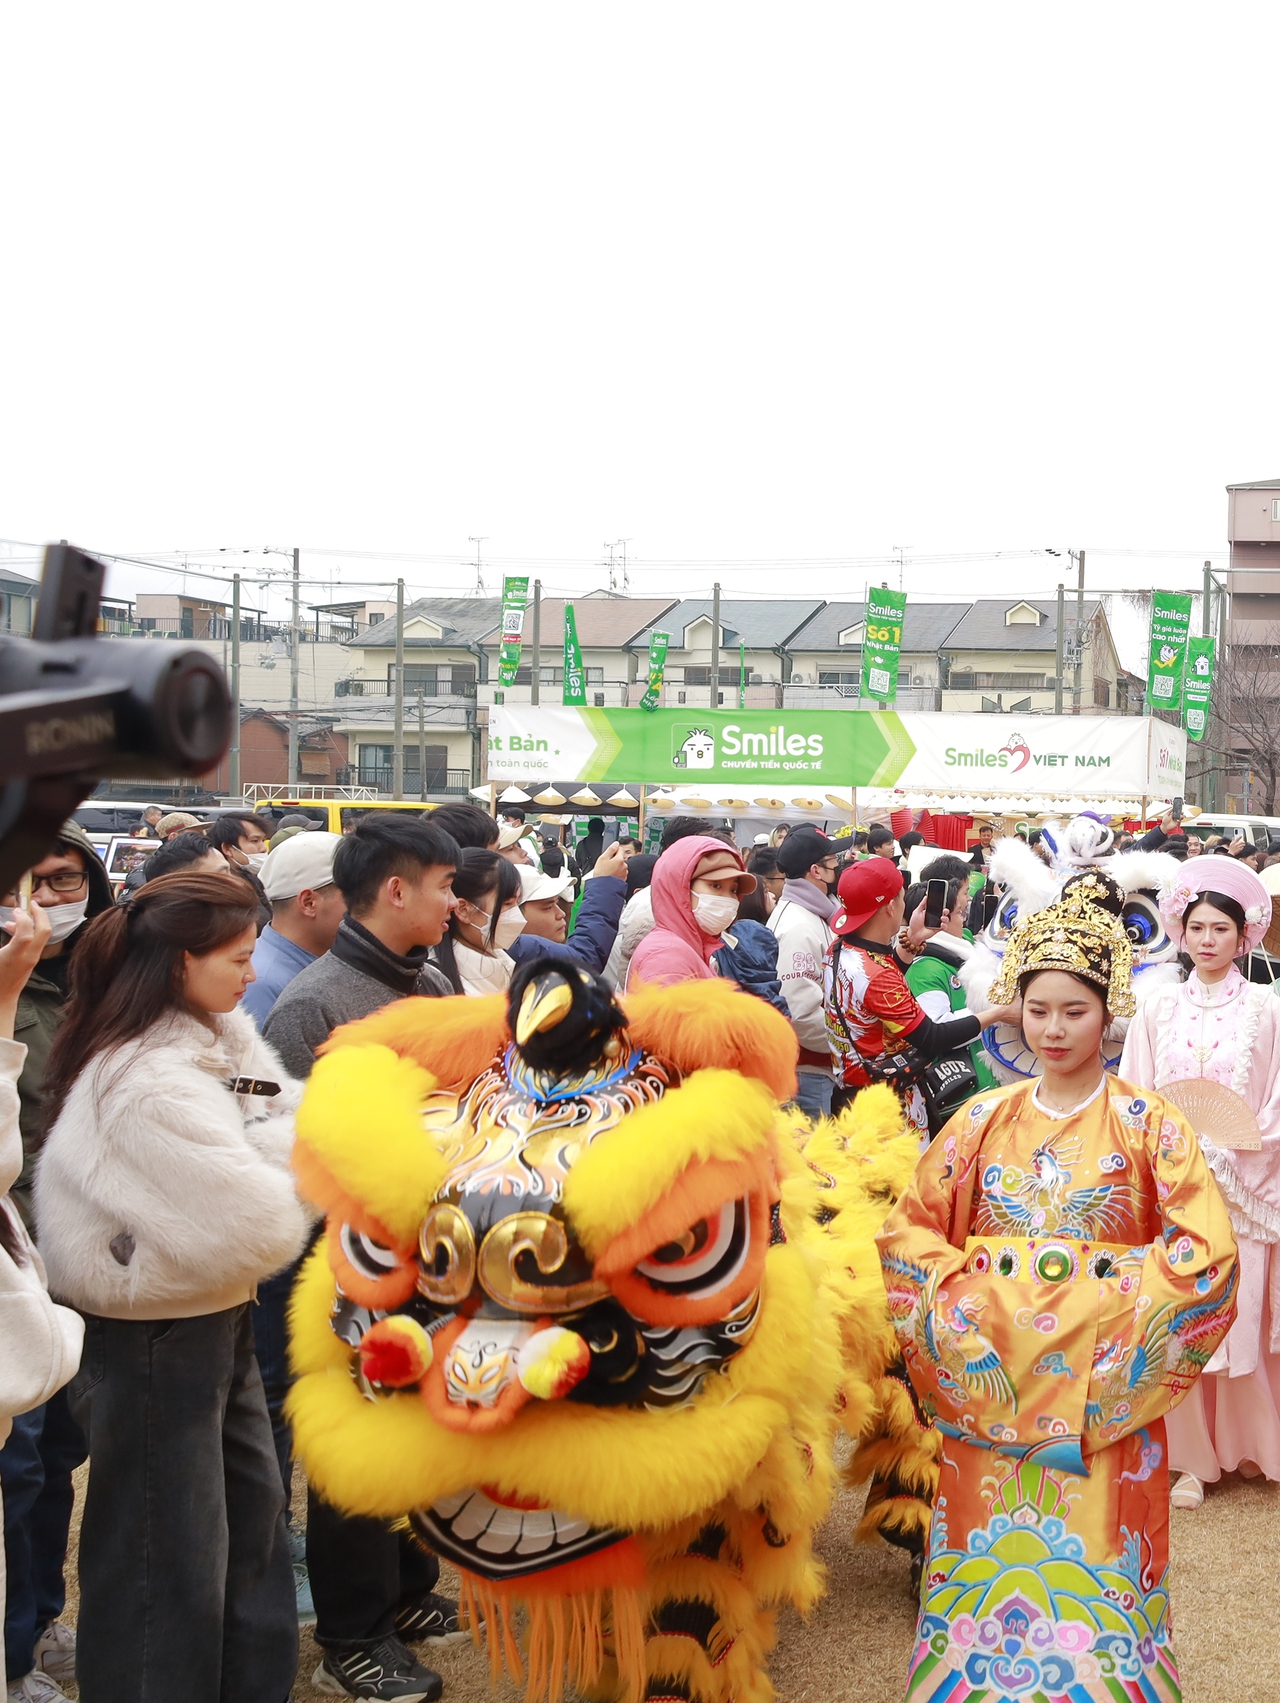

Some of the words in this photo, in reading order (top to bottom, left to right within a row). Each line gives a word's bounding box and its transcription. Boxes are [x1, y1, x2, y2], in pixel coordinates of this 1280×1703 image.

[869, 602, 903, 618] Smiles
[1154, 607, 1189, 621] Smiles
[867, 624, 891, 641] Số
[892, 627, 901, 643] 1
[1152, 633, 1166, 641] cao
[1185, 677, 1210, 690] Smiles
[509, 733, 548, 752] Bản
[721, 725, 824, 757] Smiles
[496, 758, 520, 767] toàn
[523, 758, 549, 769] quốc
[782, 759, 810, 771] QUỐC
[811, 759, 823, 770] TẾ
[944, 747, 1008, 768] Smiles
[1075, 755, 1111, 767] NAM
